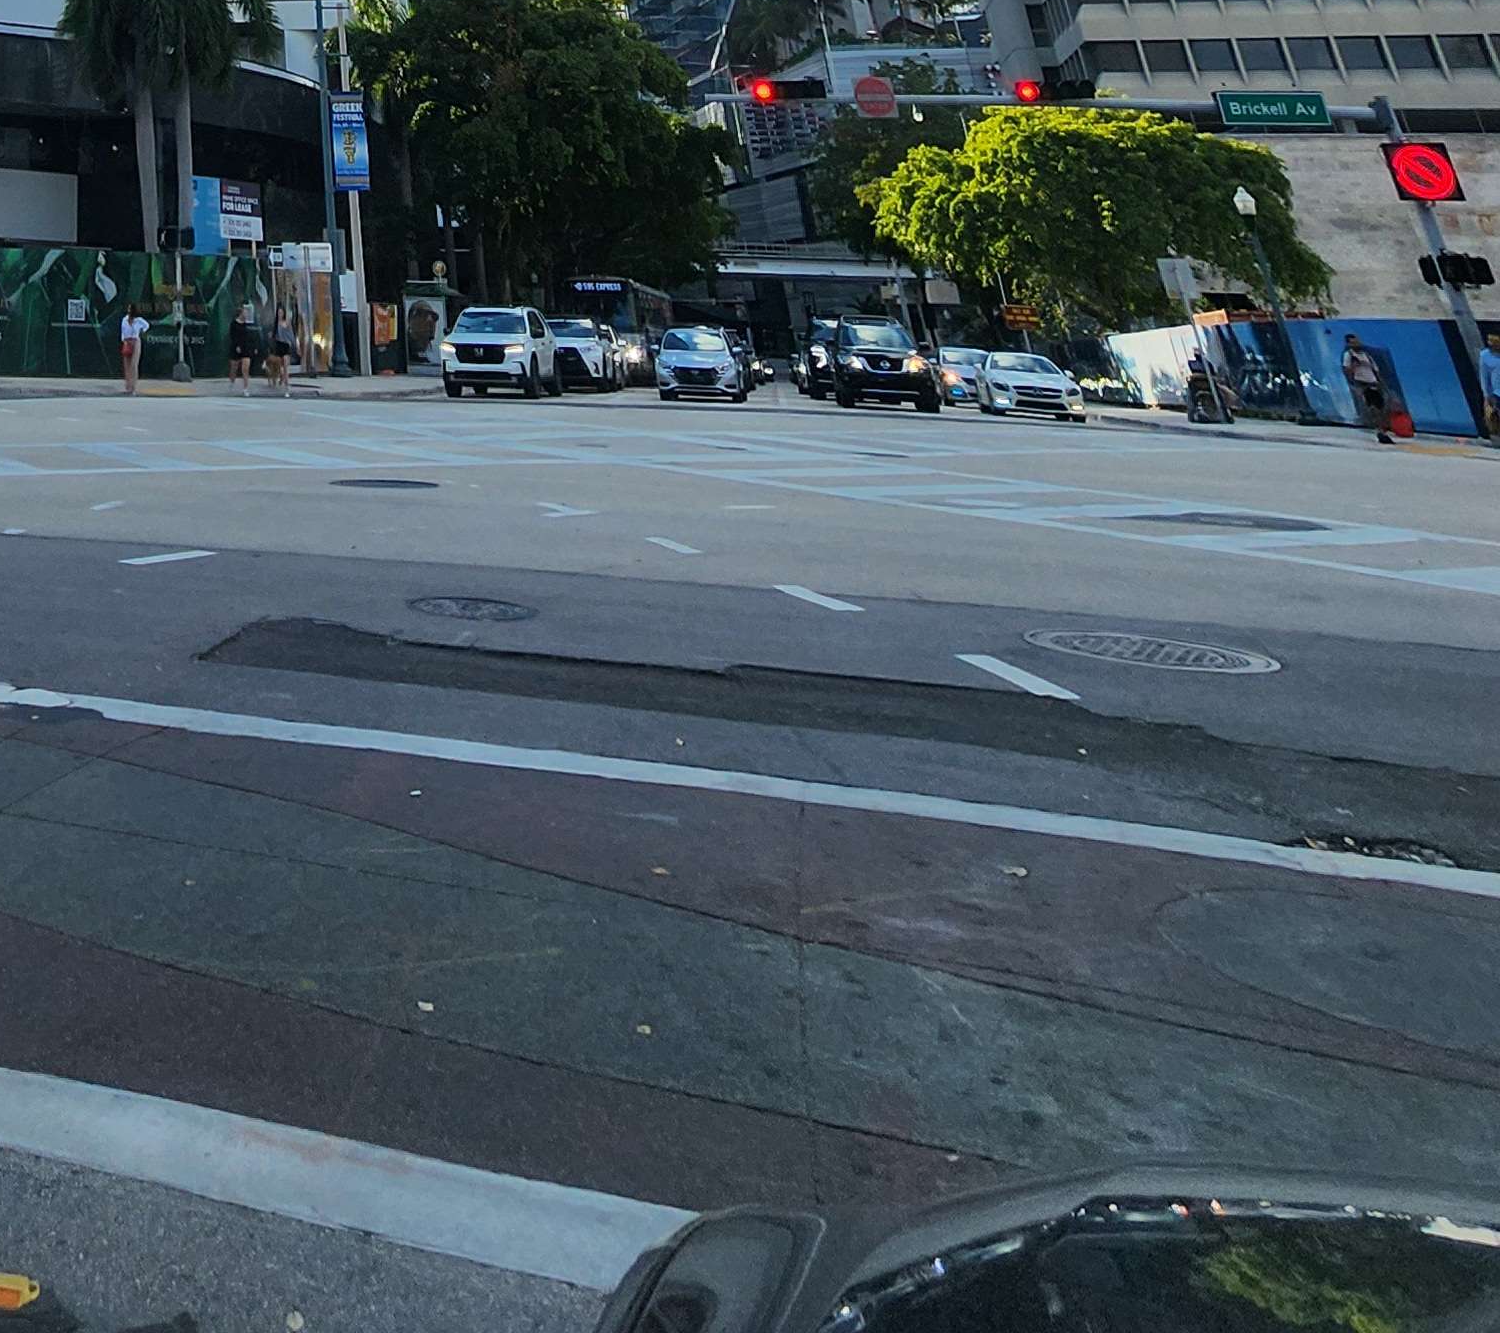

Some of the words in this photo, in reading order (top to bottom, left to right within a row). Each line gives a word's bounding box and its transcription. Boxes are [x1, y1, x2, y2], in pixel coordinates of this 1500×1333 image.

[332, 102, 364, 114] GREEK
[1229, 101, 1288, 115] Brickell
[1295, 102, 1317, 116] Av
